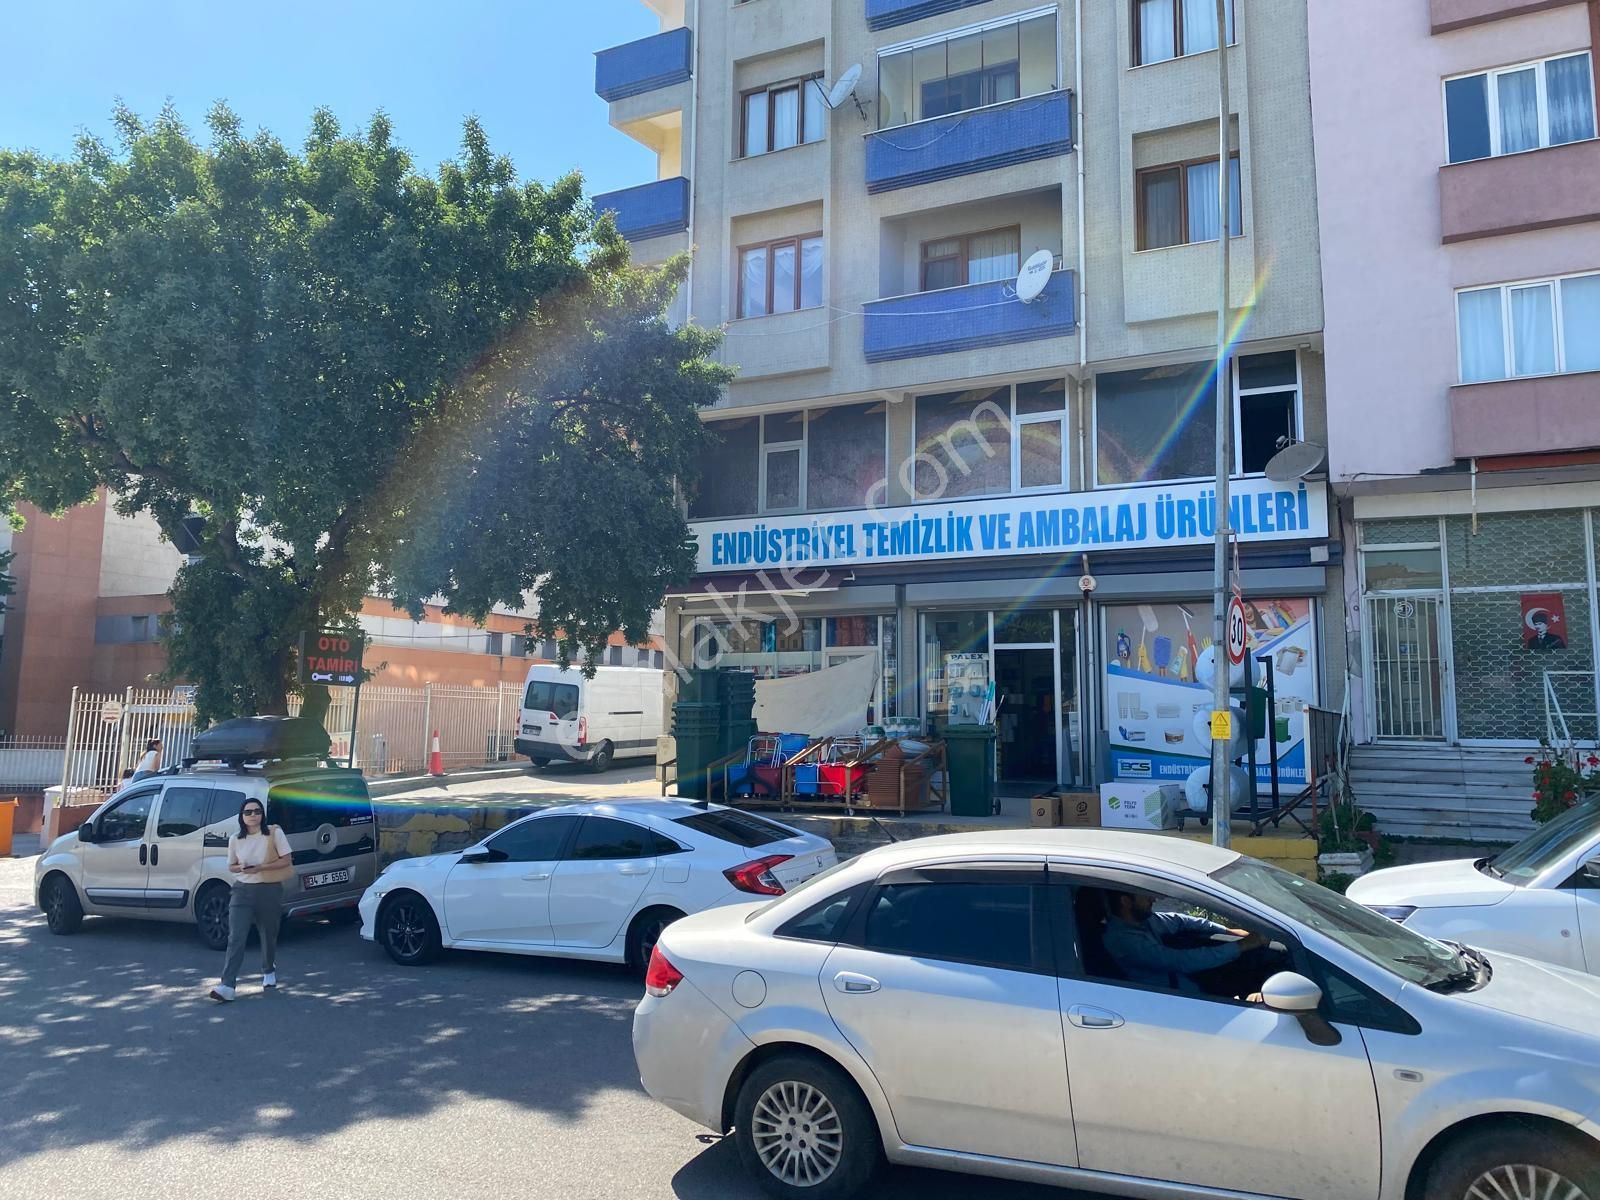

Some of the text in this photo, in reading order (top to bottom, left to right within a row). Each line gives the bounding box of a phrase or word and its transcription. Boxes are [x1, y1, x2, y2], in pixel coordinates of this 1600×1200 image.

[712, 521, 856, 565] ENDÜSTRİYEL
[862, 511, 973, 557] TEMİZLİK
[979, 512, 1011, 549] VE
[1017, 502, 1147, 548] AMBALAJ
[1231, 614, 1243, 647] 30
[319, 636, 350, 652] OTO
[1121, 762, 1150, 771] BCS
[309, 876, 318, 885] 34
